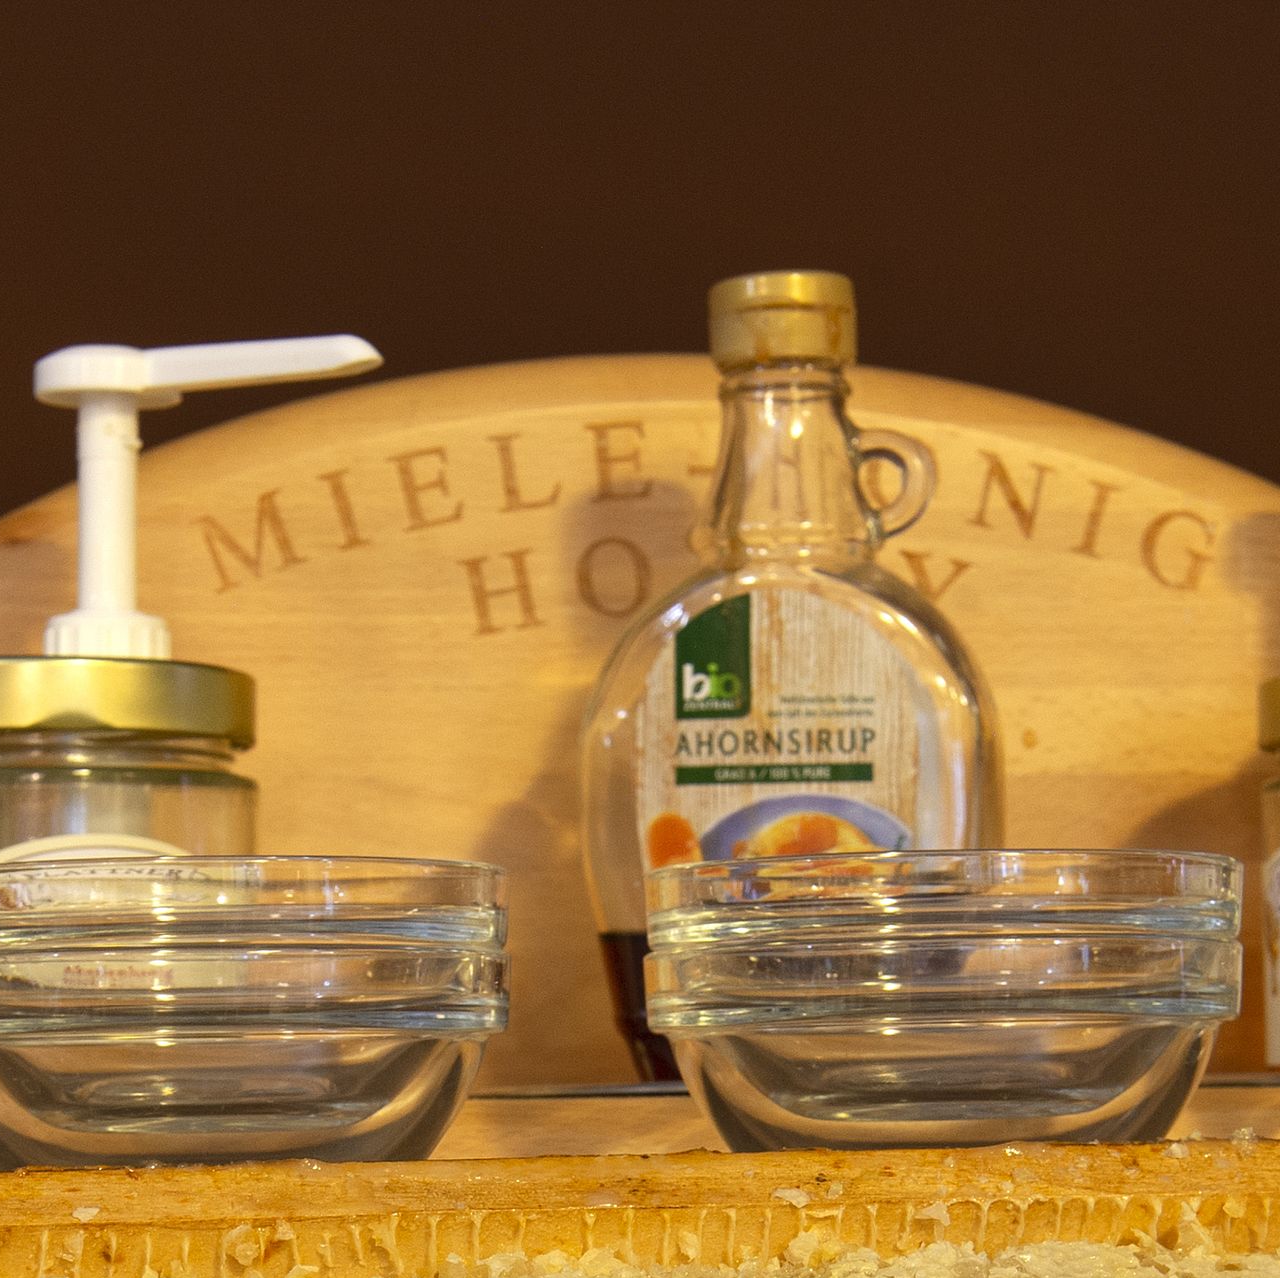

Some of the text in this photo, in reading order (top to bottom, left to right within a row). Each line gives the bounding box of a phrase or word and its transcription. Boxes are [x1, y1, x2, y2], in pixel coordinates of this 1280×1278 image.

[458, 537, 972, 636] HOY
[682, 662, 742, 700] bio
[675, 727, 877, 758] AHORNSIRUP
